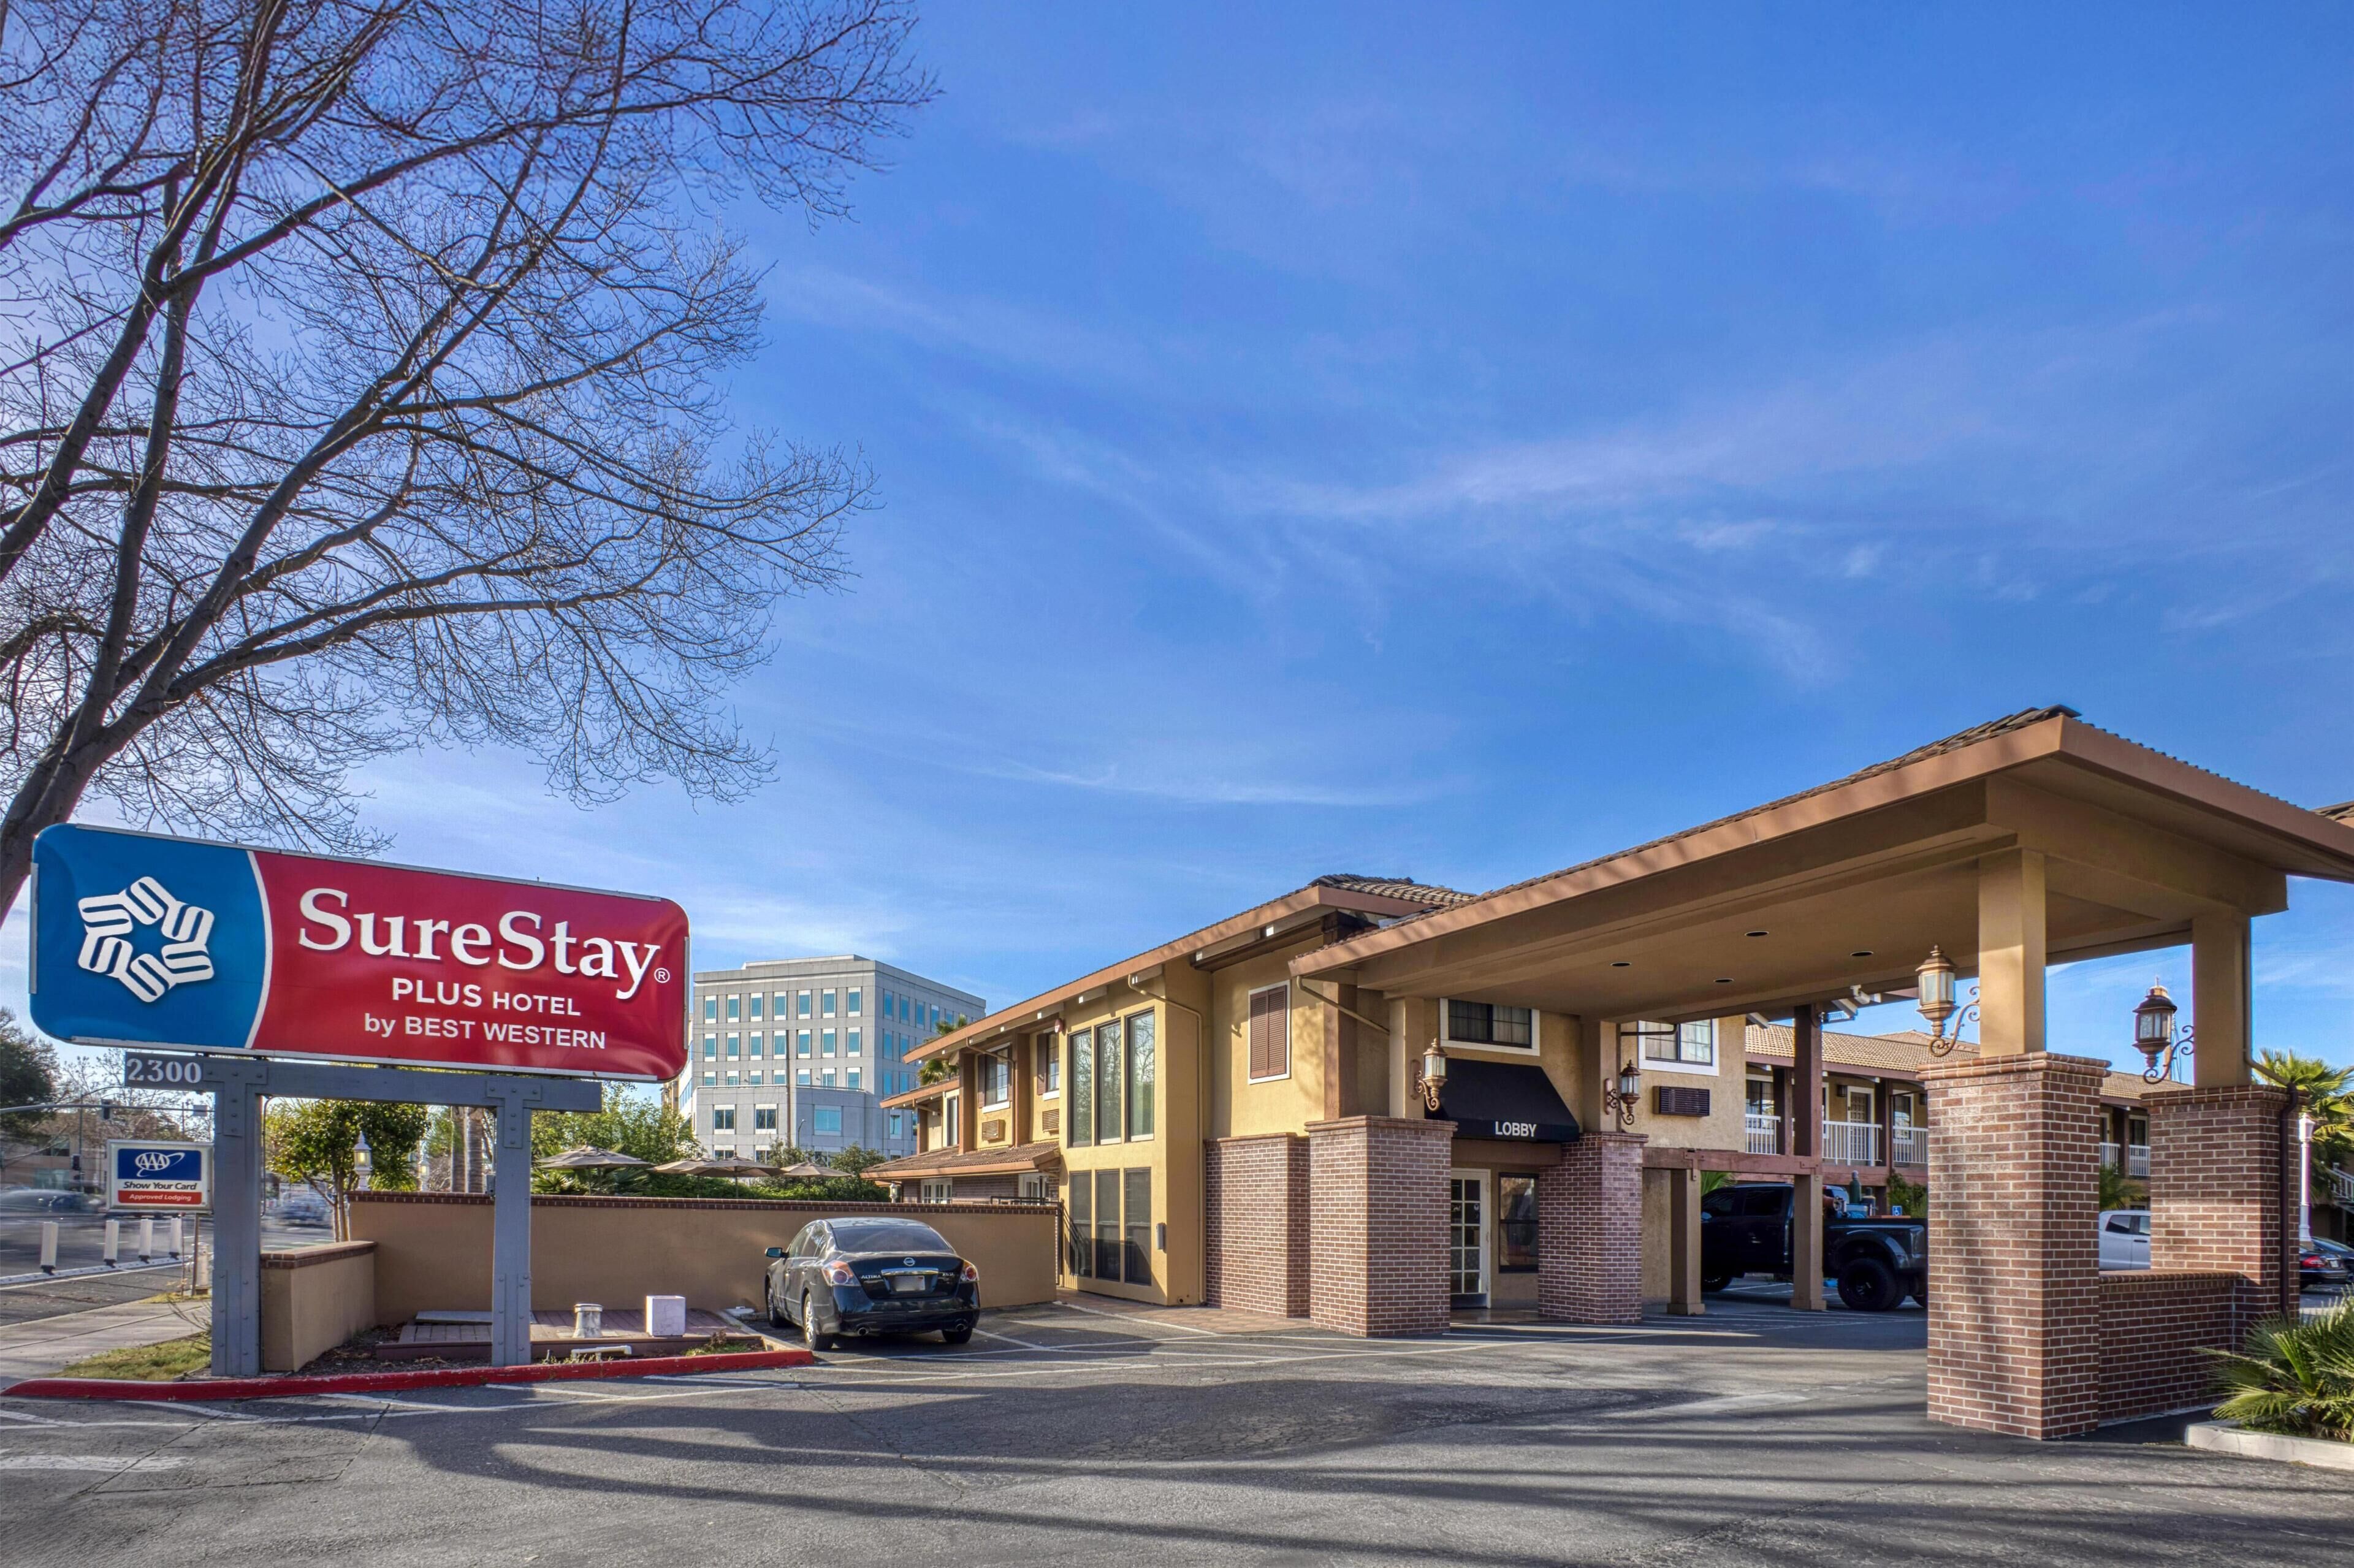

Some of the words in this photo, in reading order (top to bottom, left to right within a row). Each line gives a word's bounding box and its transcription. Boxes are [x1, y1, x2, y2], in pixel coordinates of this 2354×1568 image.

[392, 978, 482, 1007] PLUS
[492, 991, 581, 1016] HOTEL
[365, 1013, 396, 1037] by
[405, 1016, 476, 1038] BEST
[482, 1022, 606, 1049] WESTERN
[126, 1058, 202, 1083] 2300
[1495, 1121, 1537, 1137] LOBBY
[138, 1152, 169, 1171] AAA
